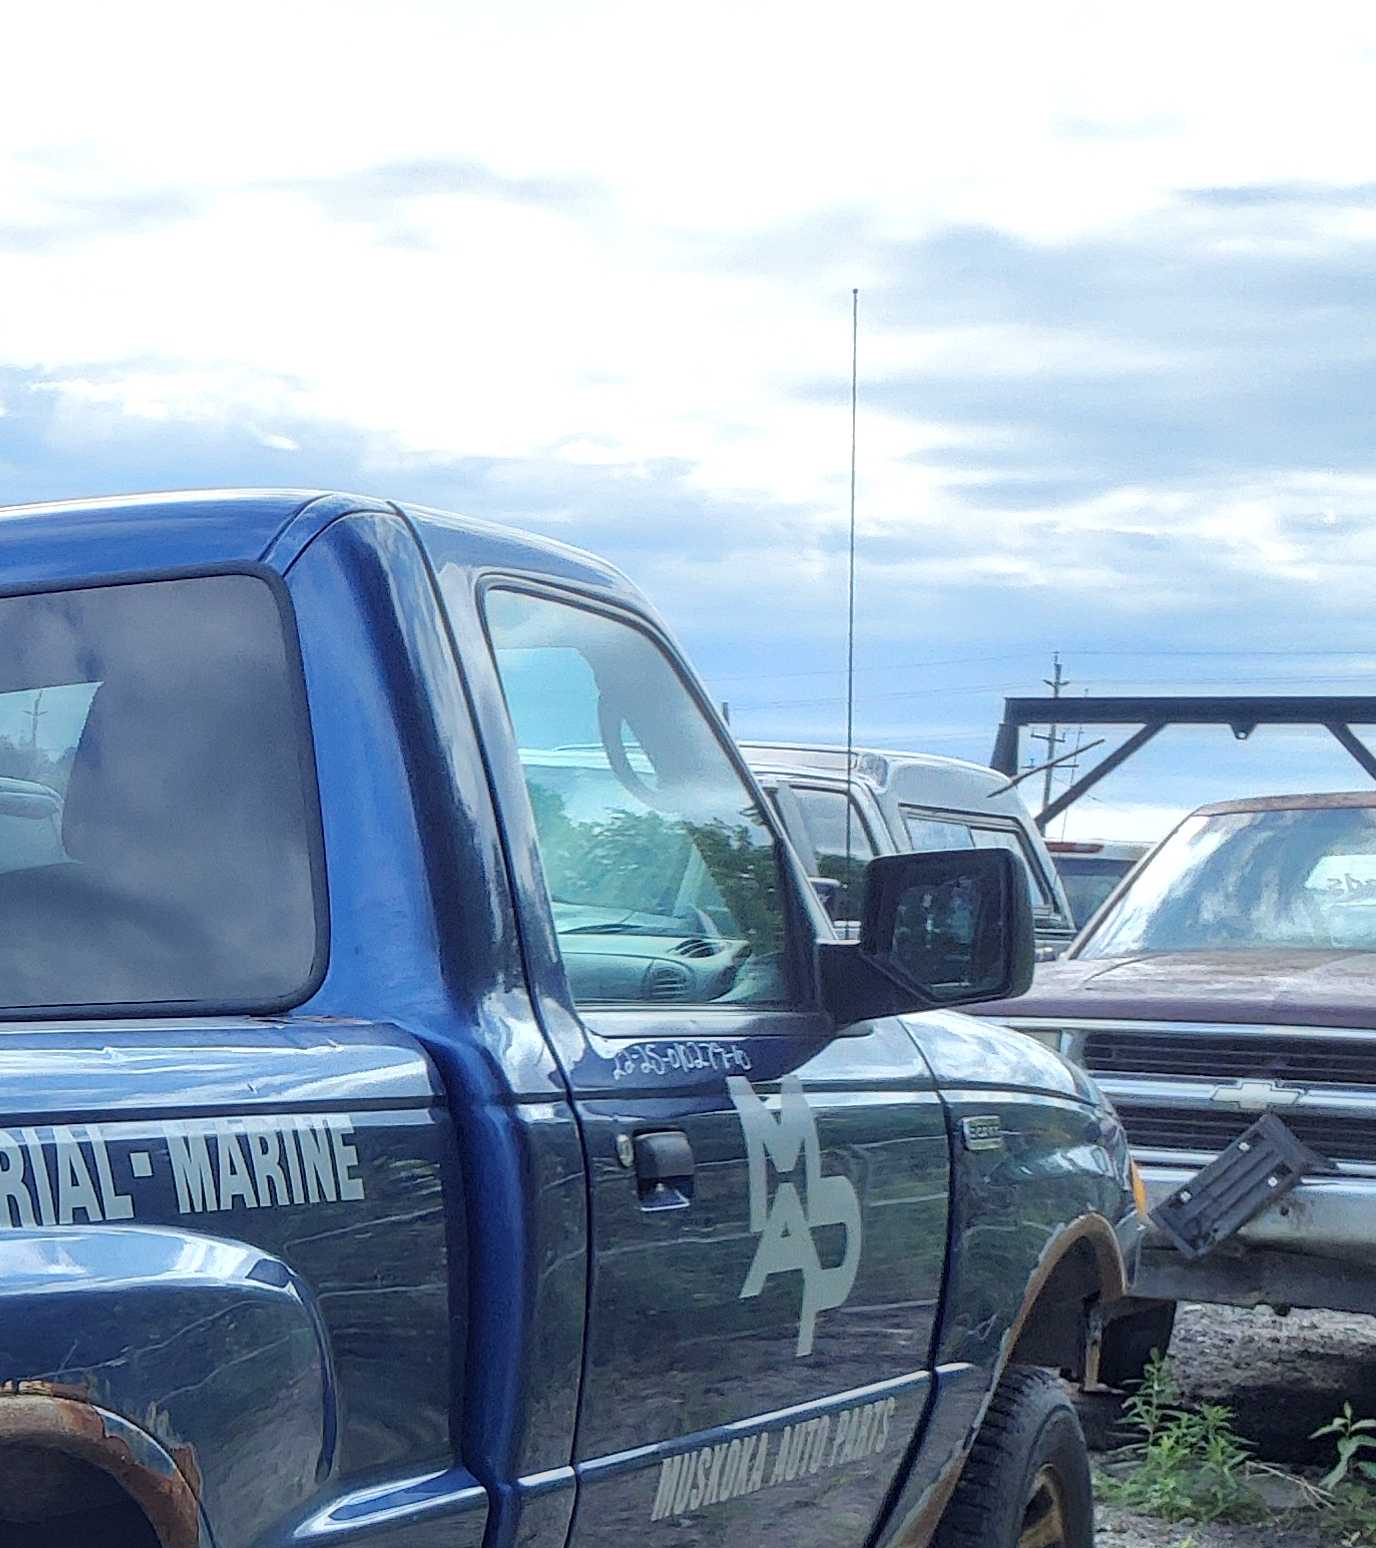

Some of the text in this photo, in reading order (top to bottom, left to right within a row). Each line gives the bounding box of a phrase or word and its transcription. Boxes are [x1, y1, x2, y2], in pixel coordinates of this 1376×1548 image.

[166, 1112, 366, 1215] MARINE
[651, 1396, 896, 1522] MUSKOKA AUTO PARTS
